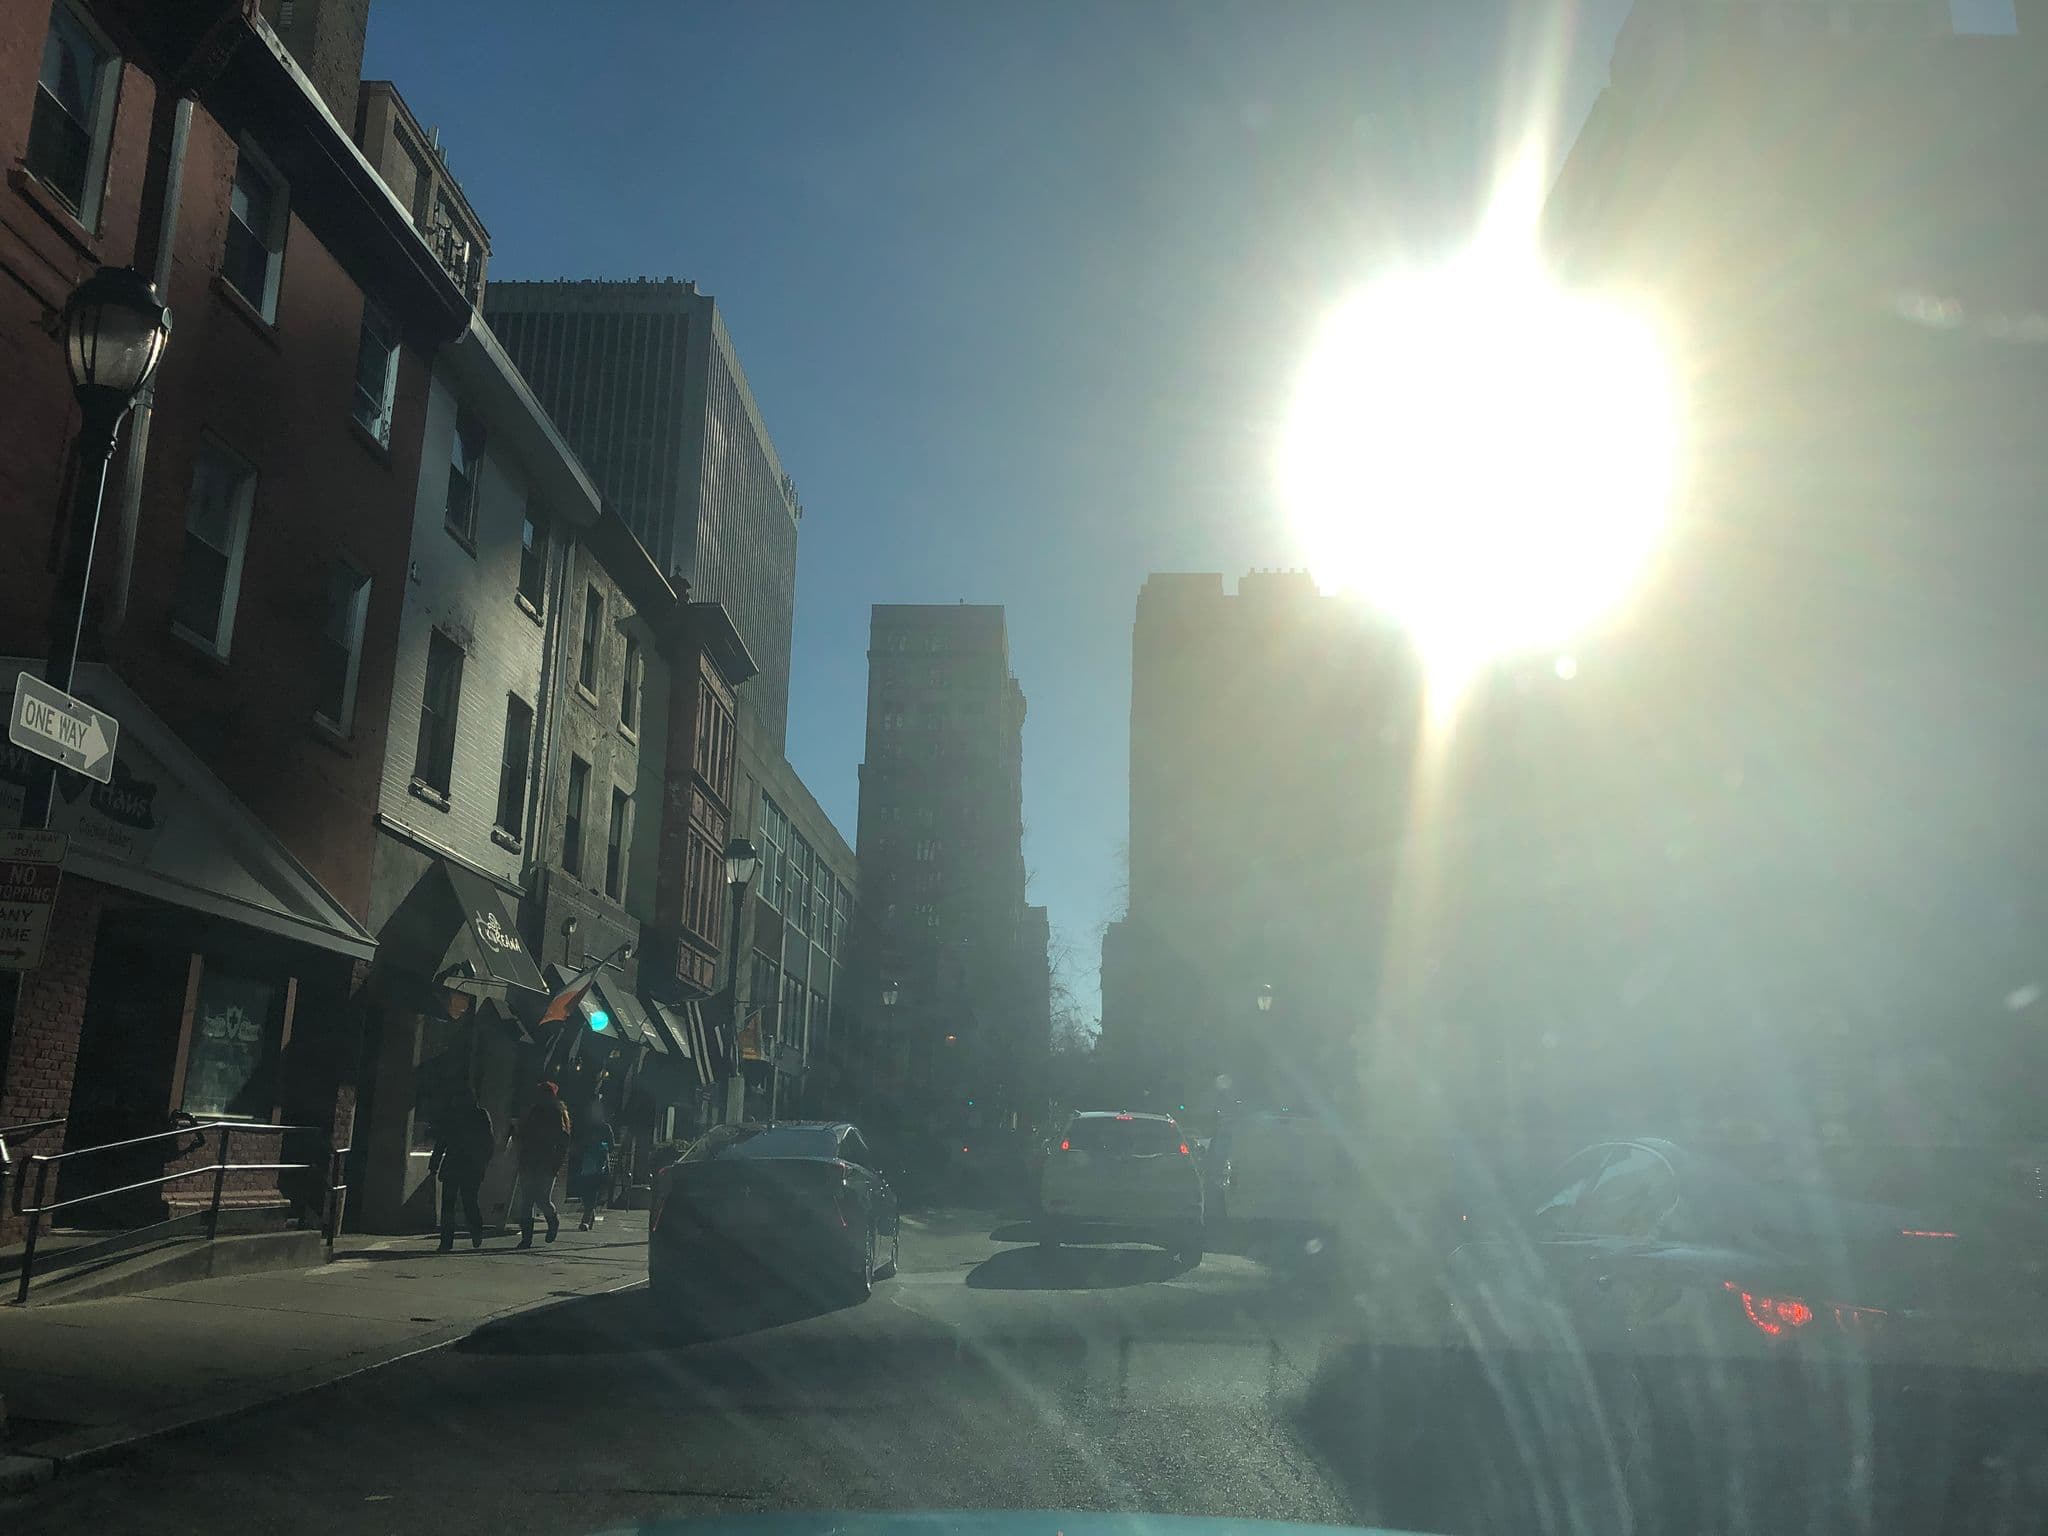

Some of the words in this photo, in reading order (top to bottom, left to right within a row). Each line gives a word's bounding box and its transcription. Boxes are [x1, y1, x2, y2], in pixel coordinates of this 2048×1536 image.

[25, 700, 56, 735] ONE
[58, 715, 88, 749] WAY
[10, 865, 37, 886] NO
[0, 885, 51, 902] TOPPING
[0, 908, 33, 923] ANY
[0, 928, 31, 942] IME
